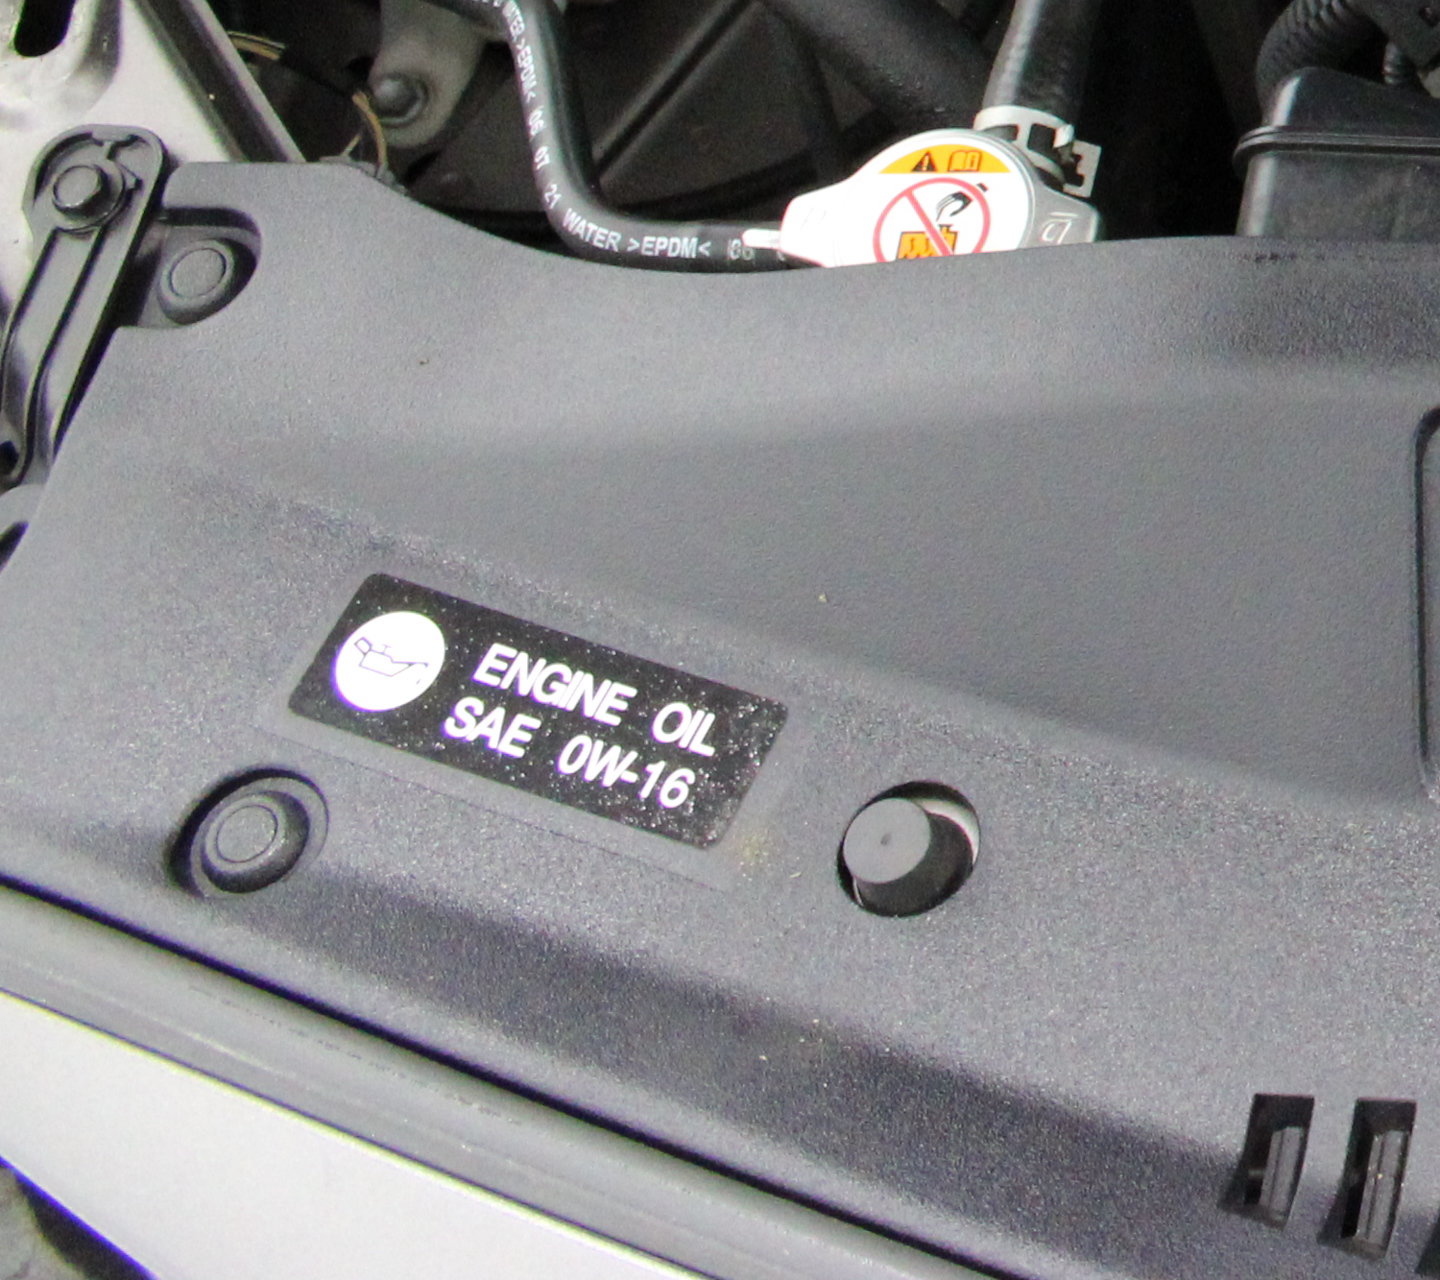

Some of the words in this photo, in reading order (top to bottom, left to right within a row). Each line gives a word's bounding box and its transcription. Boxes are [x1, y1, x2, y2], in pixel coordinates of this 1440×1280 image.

[545, 183, 562, 209] 21
[562, 208, 622, 252] WATER
[442, 696, 542, 759] SAE
[556, 734, 696, 809] 0W-16
[472, 643, 638, 727] ENGINE
[651, 702, 717, 758] OIL
